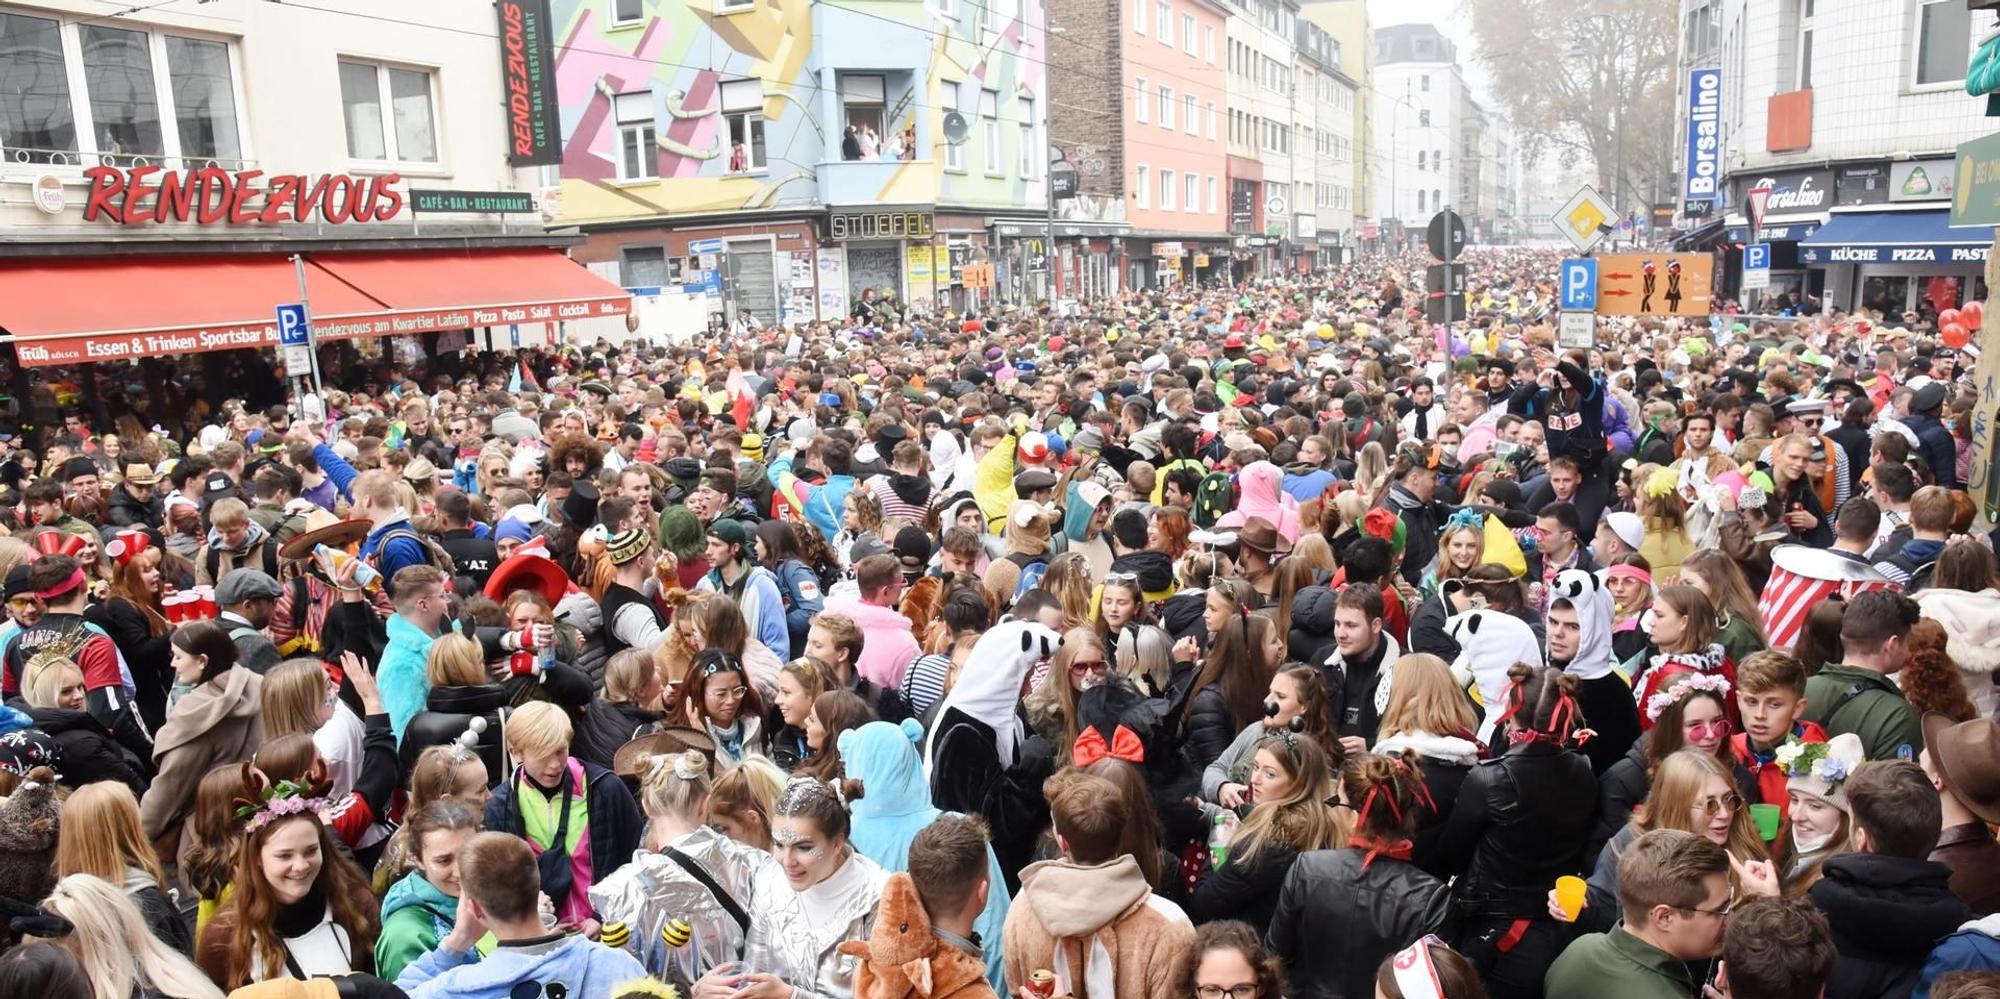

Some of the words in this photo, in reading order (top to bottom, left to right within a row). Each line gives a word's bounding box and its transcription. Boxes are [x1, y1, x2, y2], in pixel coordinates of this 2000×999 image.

[525, 12, 541, 81] RESTAURANT
[503, 1, 534, 157] RENDEZVOUS
[533, 90, 543, 111] BAR
[1689, 74, 1719, 193] Borsalino
[83, 165, 402, 224] RENDEZVOUS
[419, 194, 443, 209] CAFÉ
[451, 198, 467, 209] BAR
[475, 199, 528, 210] RESTAURANT
[1686, 200, 1708, 213] sky
[833, 215, 933, 237] STIEFEL
[1830, 246, 1878, 261] KÜCHE
[1891, 248, 1936, 261] PIZZA
[1951, 248, 1989, 261] PAST
[1568, 265, 1588, 303] P
[280, 309, 298, 340] P
[473, 311, 498, 323] Pizza
[502, 308, 526, 321] Pasta
[530, 305, 552, 319] Salat
[558, 302, 589, 317] Cocktail
[313, 322, 371, 338] endezvous
[374, 321, 389, 333] am
[392, 315, 435, 331] Kwartier
[86, 340, 129, 357] Essen
[131, 337, 144, 354] &
[145, 334, 196, 352] Trinken
[199, 328, 262, 349] Sportsbar
